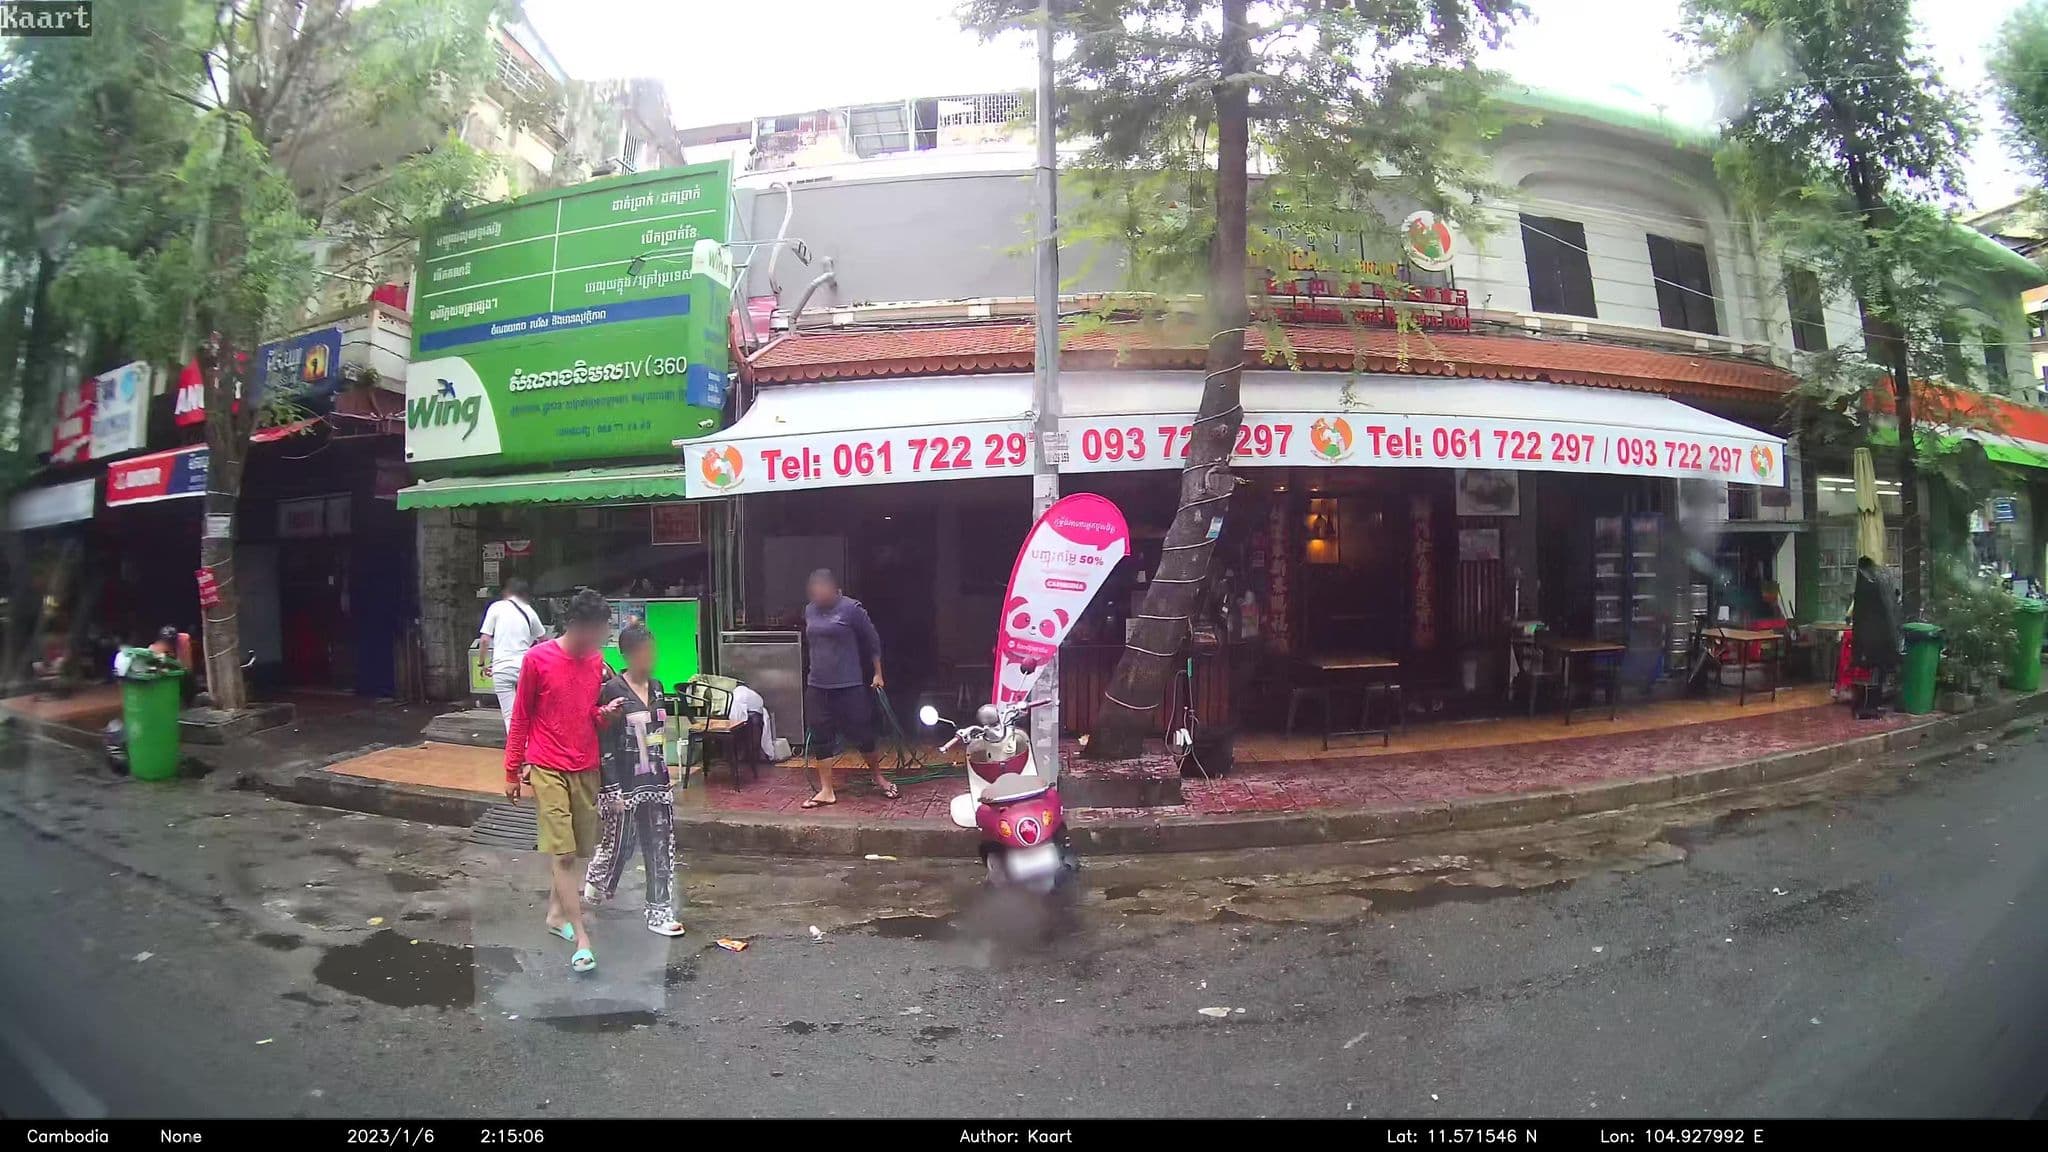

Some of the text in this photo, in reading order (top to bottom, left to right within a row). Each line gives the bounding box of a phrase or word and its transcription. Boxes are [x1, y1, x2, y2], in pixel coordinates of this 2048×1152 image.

[708, 251, 729, 281] Wing
[407, 394, 481, 441] Wing
[761, 447, 821, 481] Tel:
[833, 440, 893, 477] 061
[908, 435, 973, 472] 722
[1082, 426, 1147, 462] 093
[1366, 425, 1743, 474] Tel: 061 722 297 / 093 722 297
[1079, 555, 1104, 566] 50%
